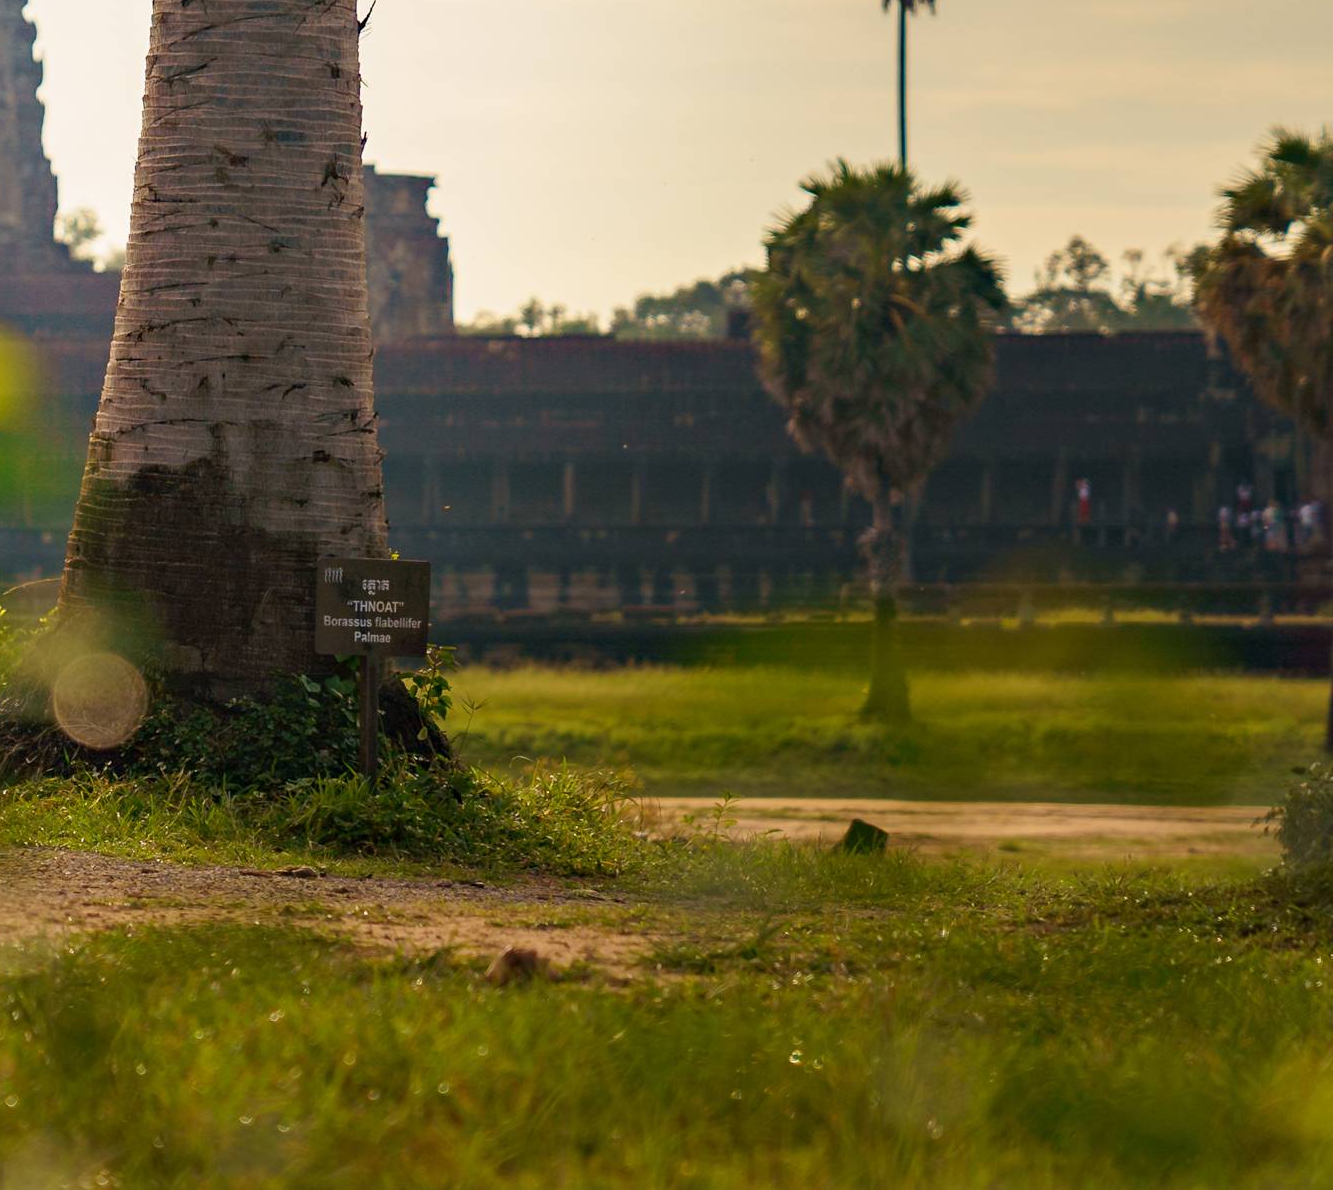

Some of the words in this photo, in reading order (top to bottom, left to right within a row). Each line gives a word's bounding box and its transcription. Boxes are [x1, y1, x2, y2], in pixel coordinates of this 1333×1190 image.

[323, 615, 372, 627] Borassus
[375, 617, 422, 629] flabellifer
[354, 631, 391, 643] Palmae
